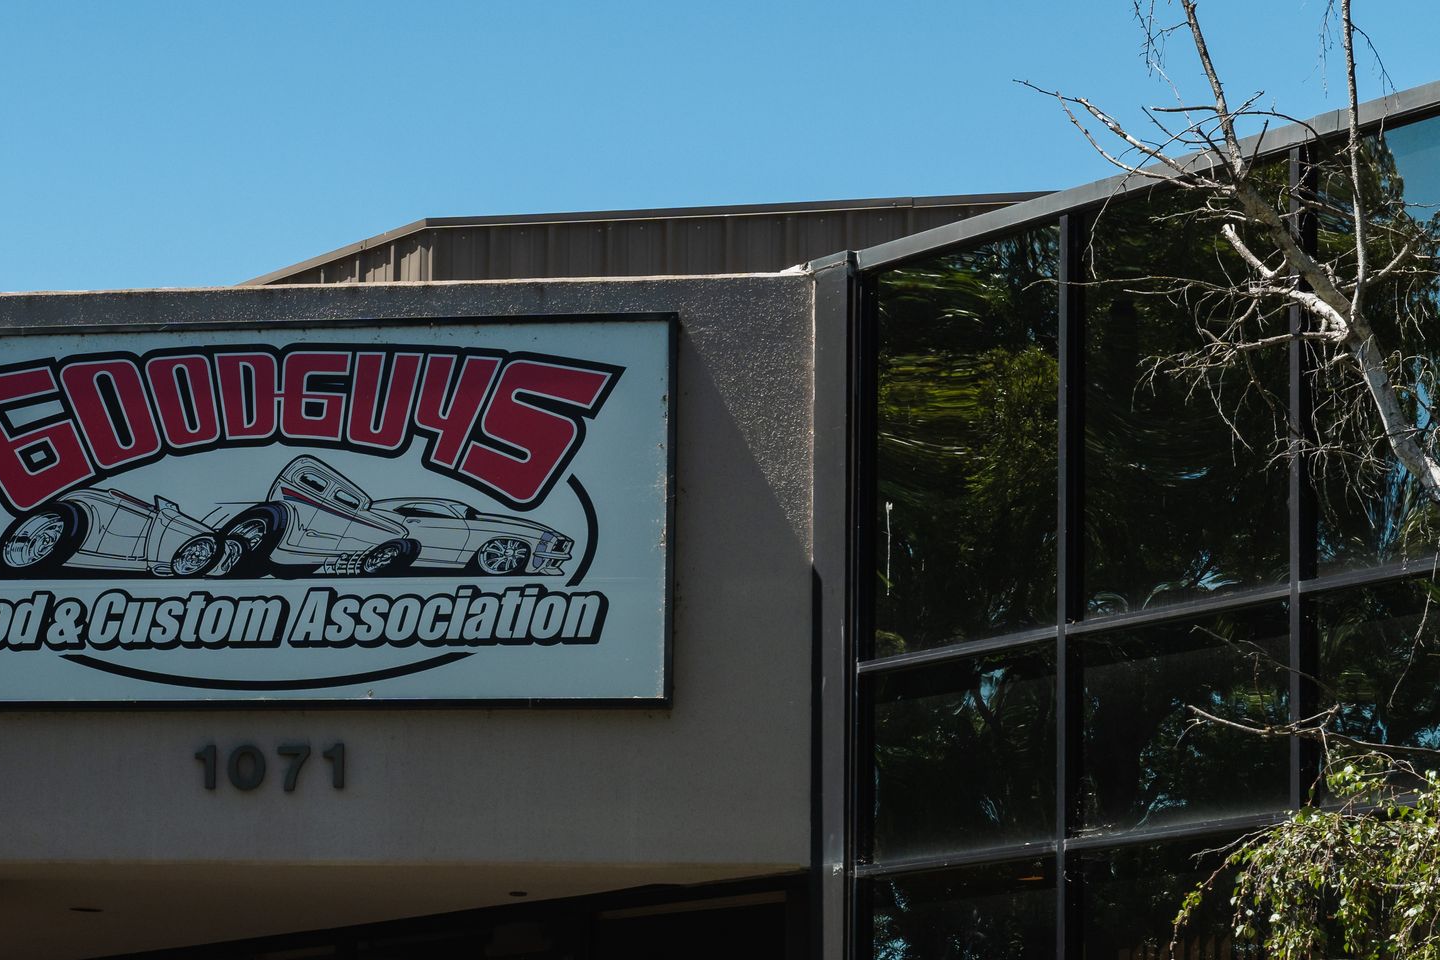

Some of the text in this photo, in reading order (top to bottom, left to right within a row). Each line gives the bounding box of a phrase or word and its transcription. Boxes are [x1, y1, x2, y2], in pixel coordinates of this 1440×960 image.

[87, 588, 290, 650] Custom
[288, 584, 609, 648] Association
[194, 743, 345, 792] 1071
